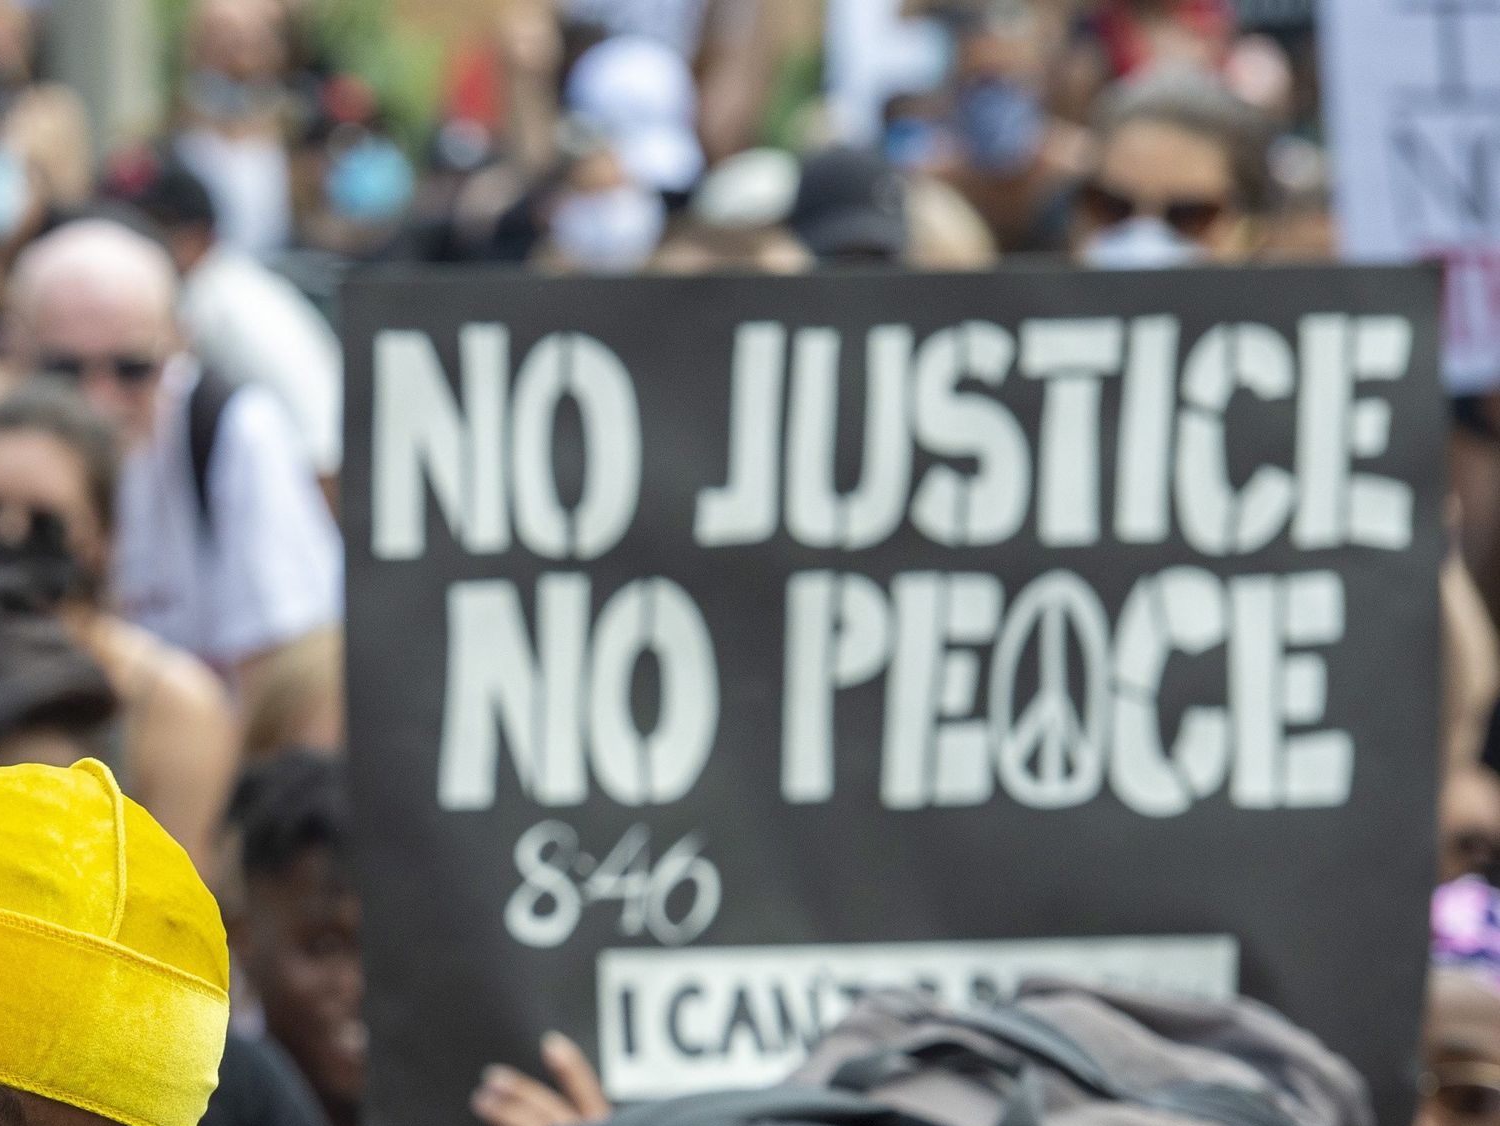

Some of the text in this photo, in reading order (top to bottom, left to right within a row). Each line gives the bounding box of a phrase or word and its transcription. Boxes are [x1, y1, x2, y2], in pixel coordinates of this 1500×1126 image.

[372, 314, 1414, 559] NO JUSTICE
[438, 571, 720, 811] NO
[618, 986, 638, 1060] I
